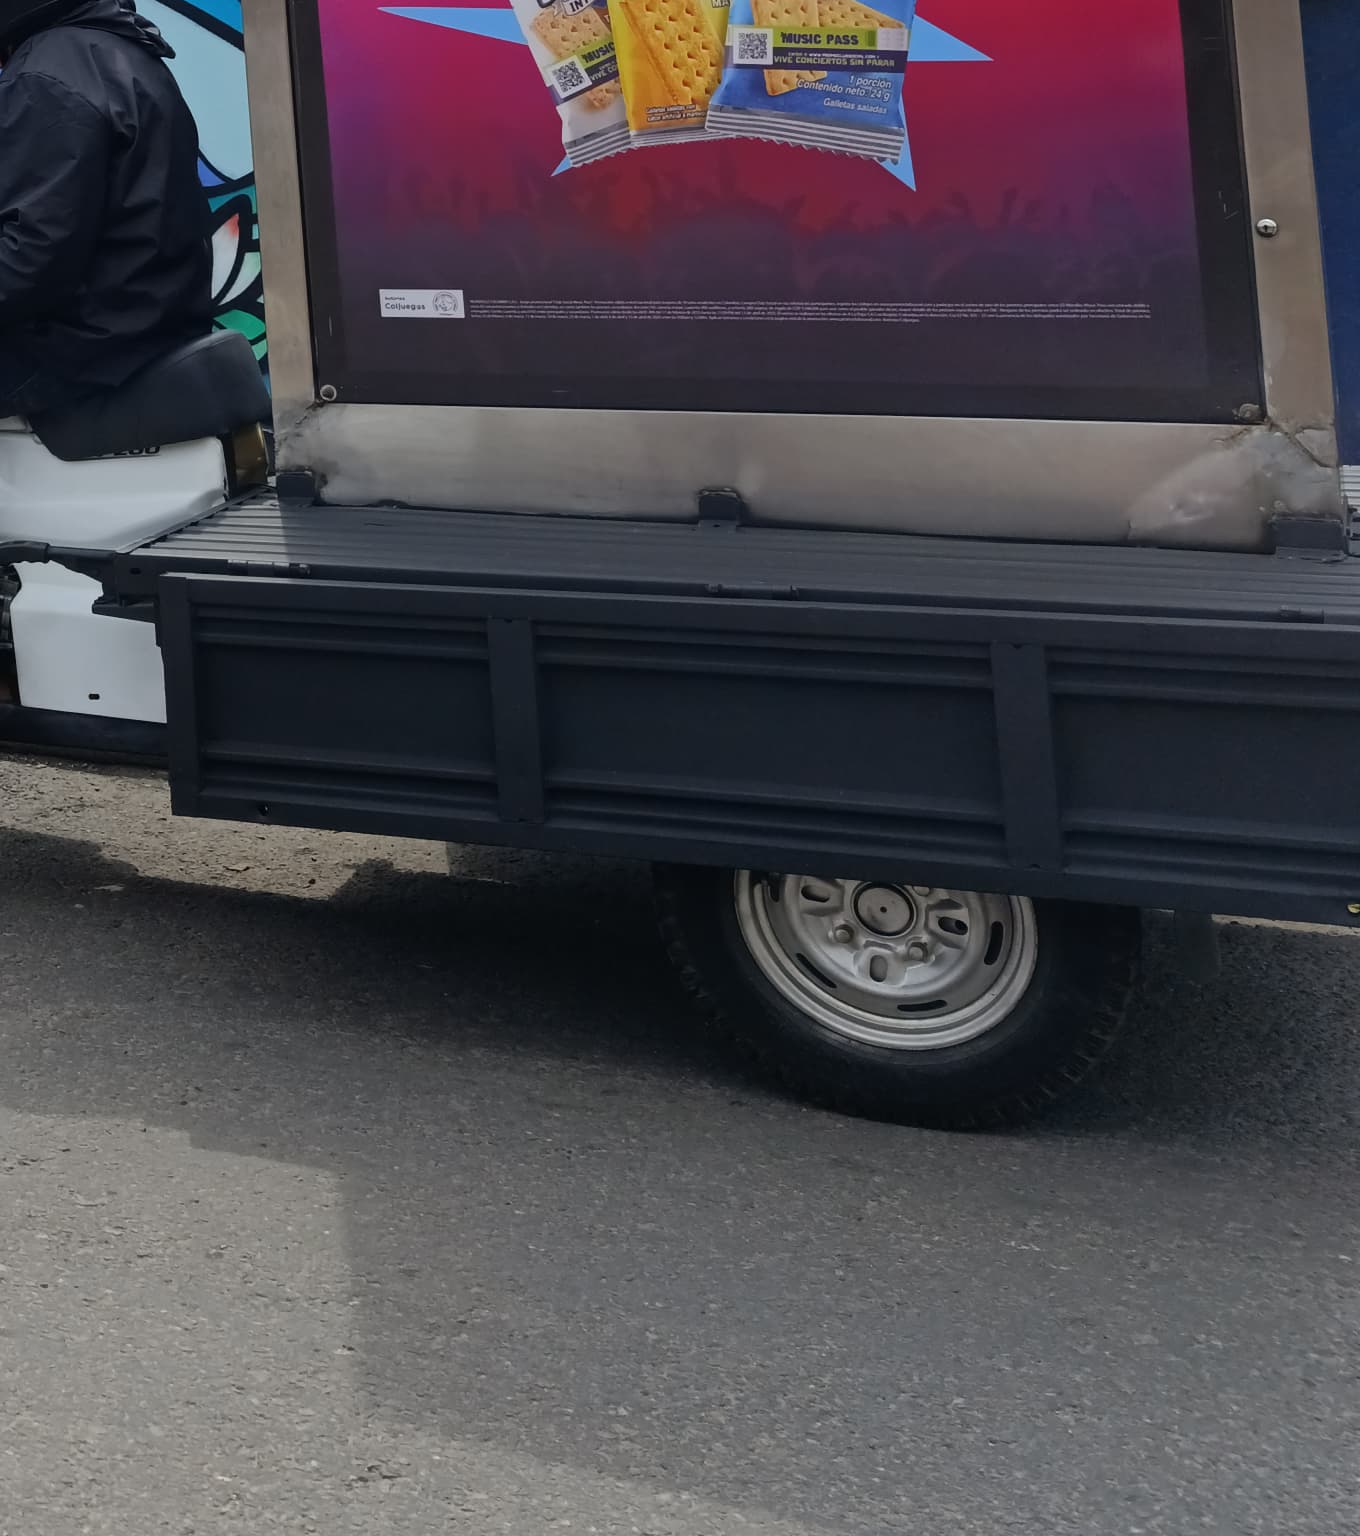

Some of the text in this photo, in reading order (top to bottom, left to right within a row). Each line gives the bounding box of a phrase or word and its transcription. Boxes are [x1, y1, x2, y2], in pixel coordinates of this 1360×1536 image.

[781, 31, 859, 45] MUSIC PASS
[774, 55, 895, 67] VIVE CONCIERTOS SIN PARAR
[849, 75, 892, 89] 1 porción
[797, 79, 843, 94] Contenido
[870, 88, 882, 98] 24
[883, 92, 890, 102] g
[823, 97, 887, 114] Galletas saladas
[384, 302, 426, 311] Coljuegos
